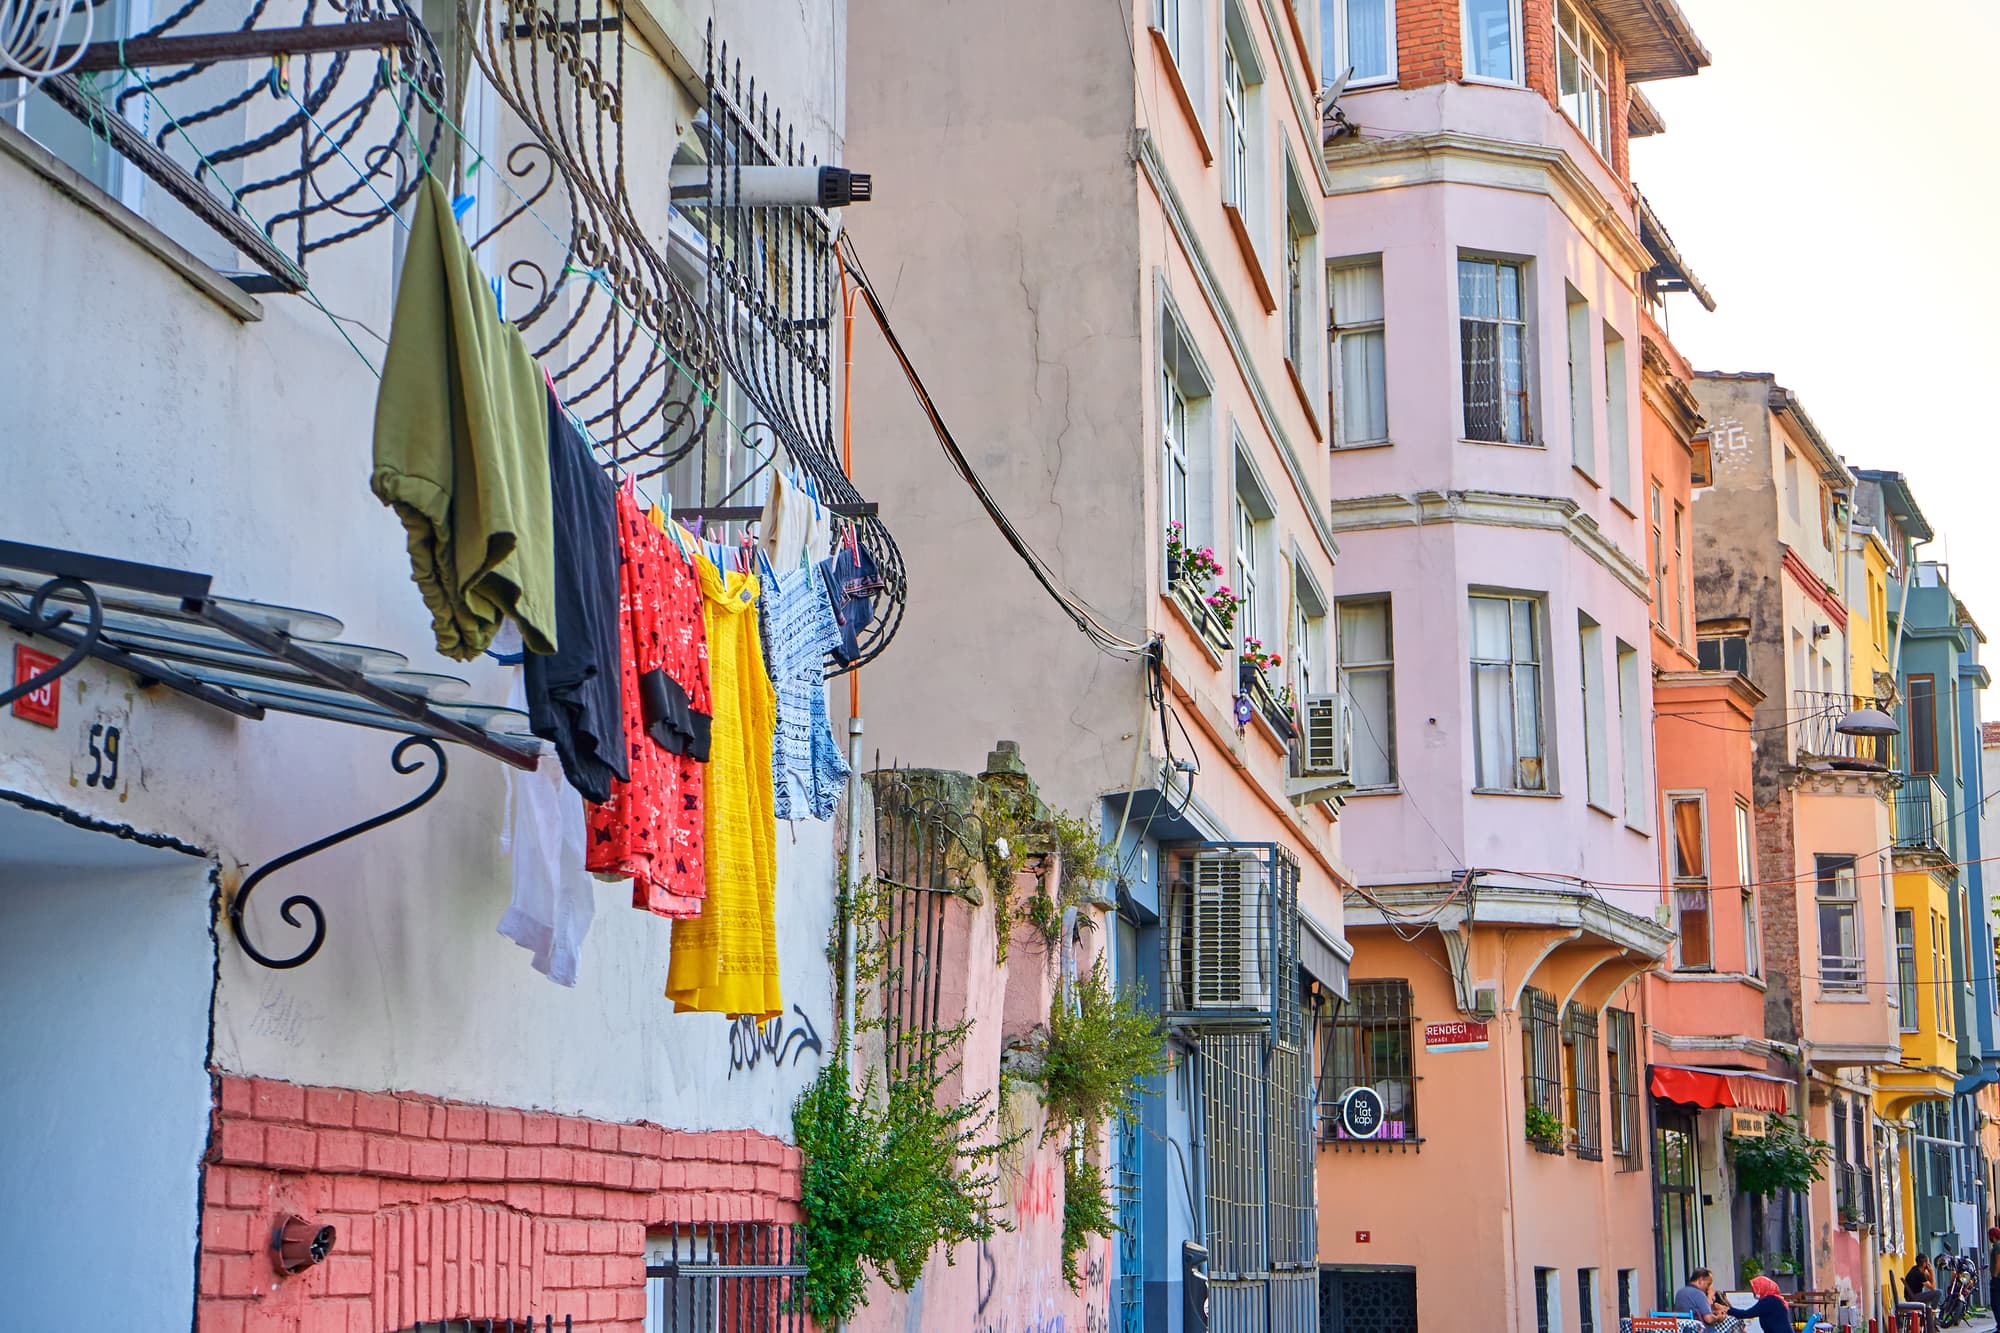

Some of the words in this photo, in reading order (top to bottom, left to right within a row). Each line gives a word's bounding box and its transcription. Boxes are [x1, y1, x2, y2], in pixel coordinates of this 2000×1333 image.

[86, 723, 120, 790] 59
[1355, 1098, 1367, 1108] ba
[1359, 1107, 1371, 1117] lat
